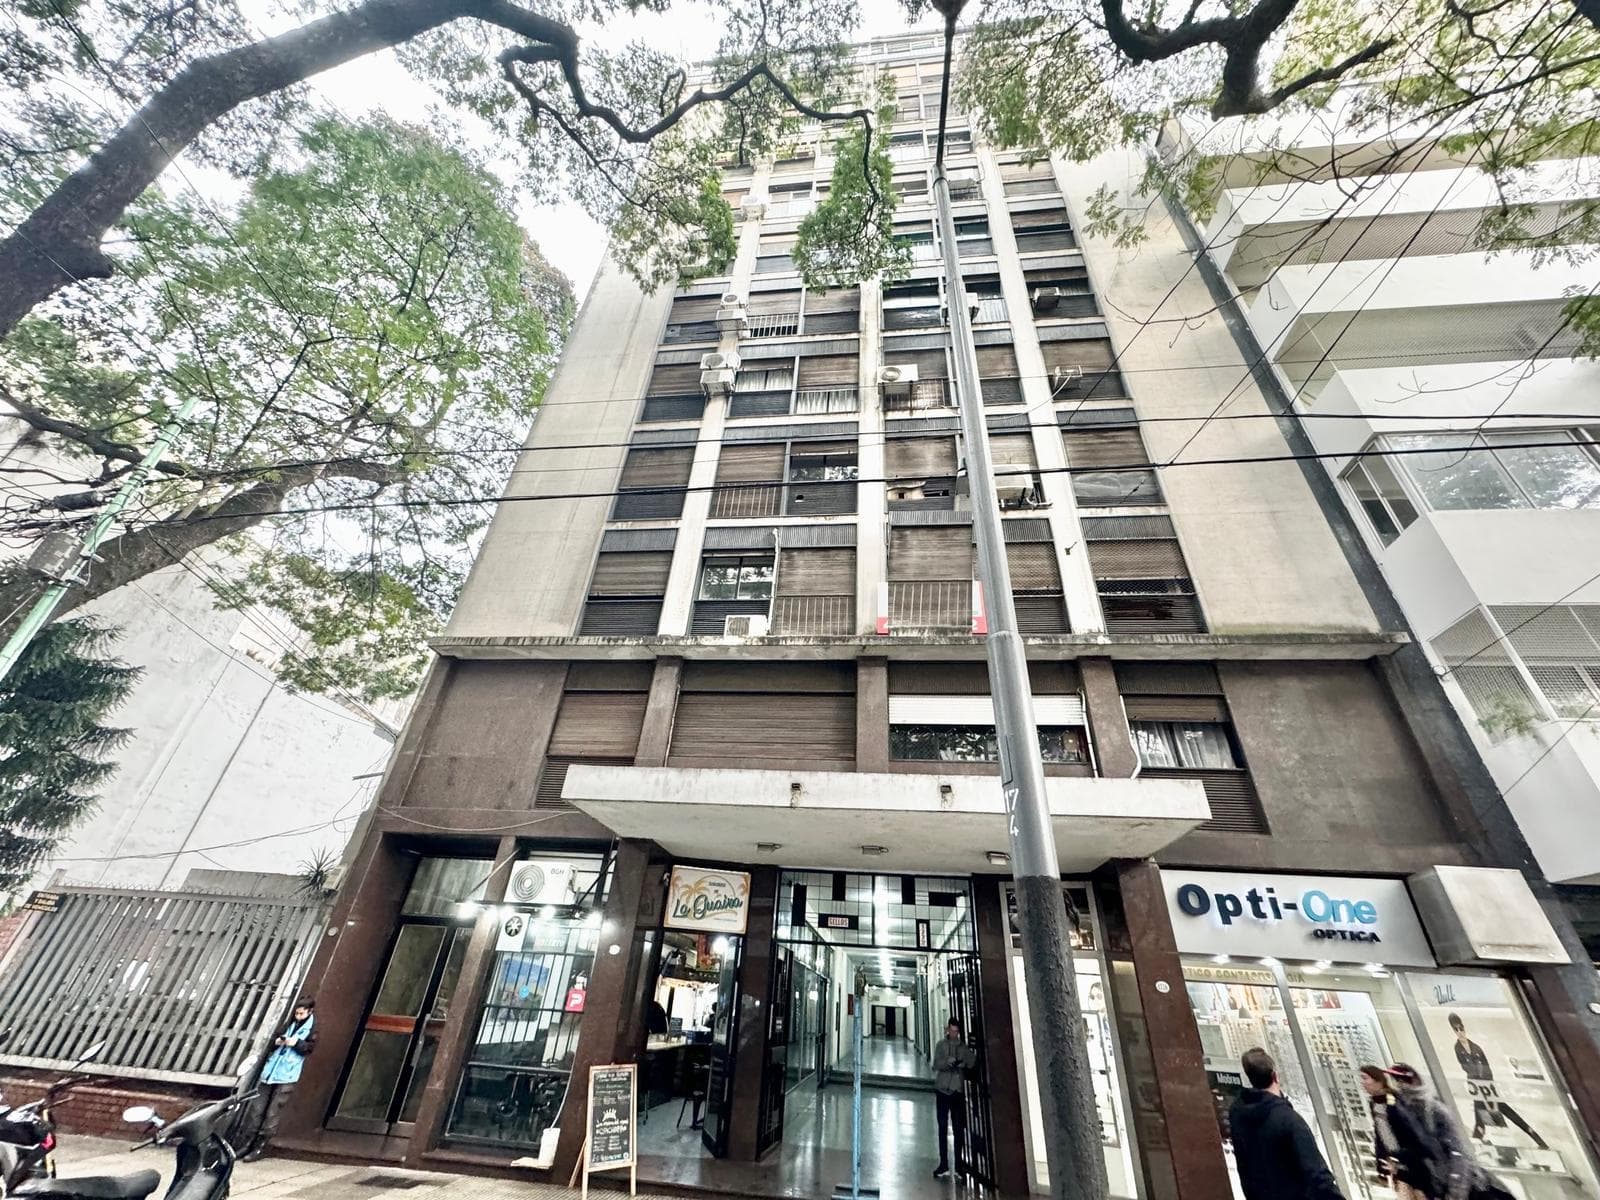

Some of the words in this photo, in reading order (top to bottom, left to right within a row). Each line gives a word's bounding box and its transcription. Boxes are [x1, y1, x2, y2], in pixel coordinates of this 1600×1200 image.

[1004, 788, 1019, 813] 17
[672, 898, 691, 919] La
[693, 894, 744, 921] Guaira
[1177, 883, 1378, 926] Opti-One
[1312, 928, 1382, 943] OPTICA
